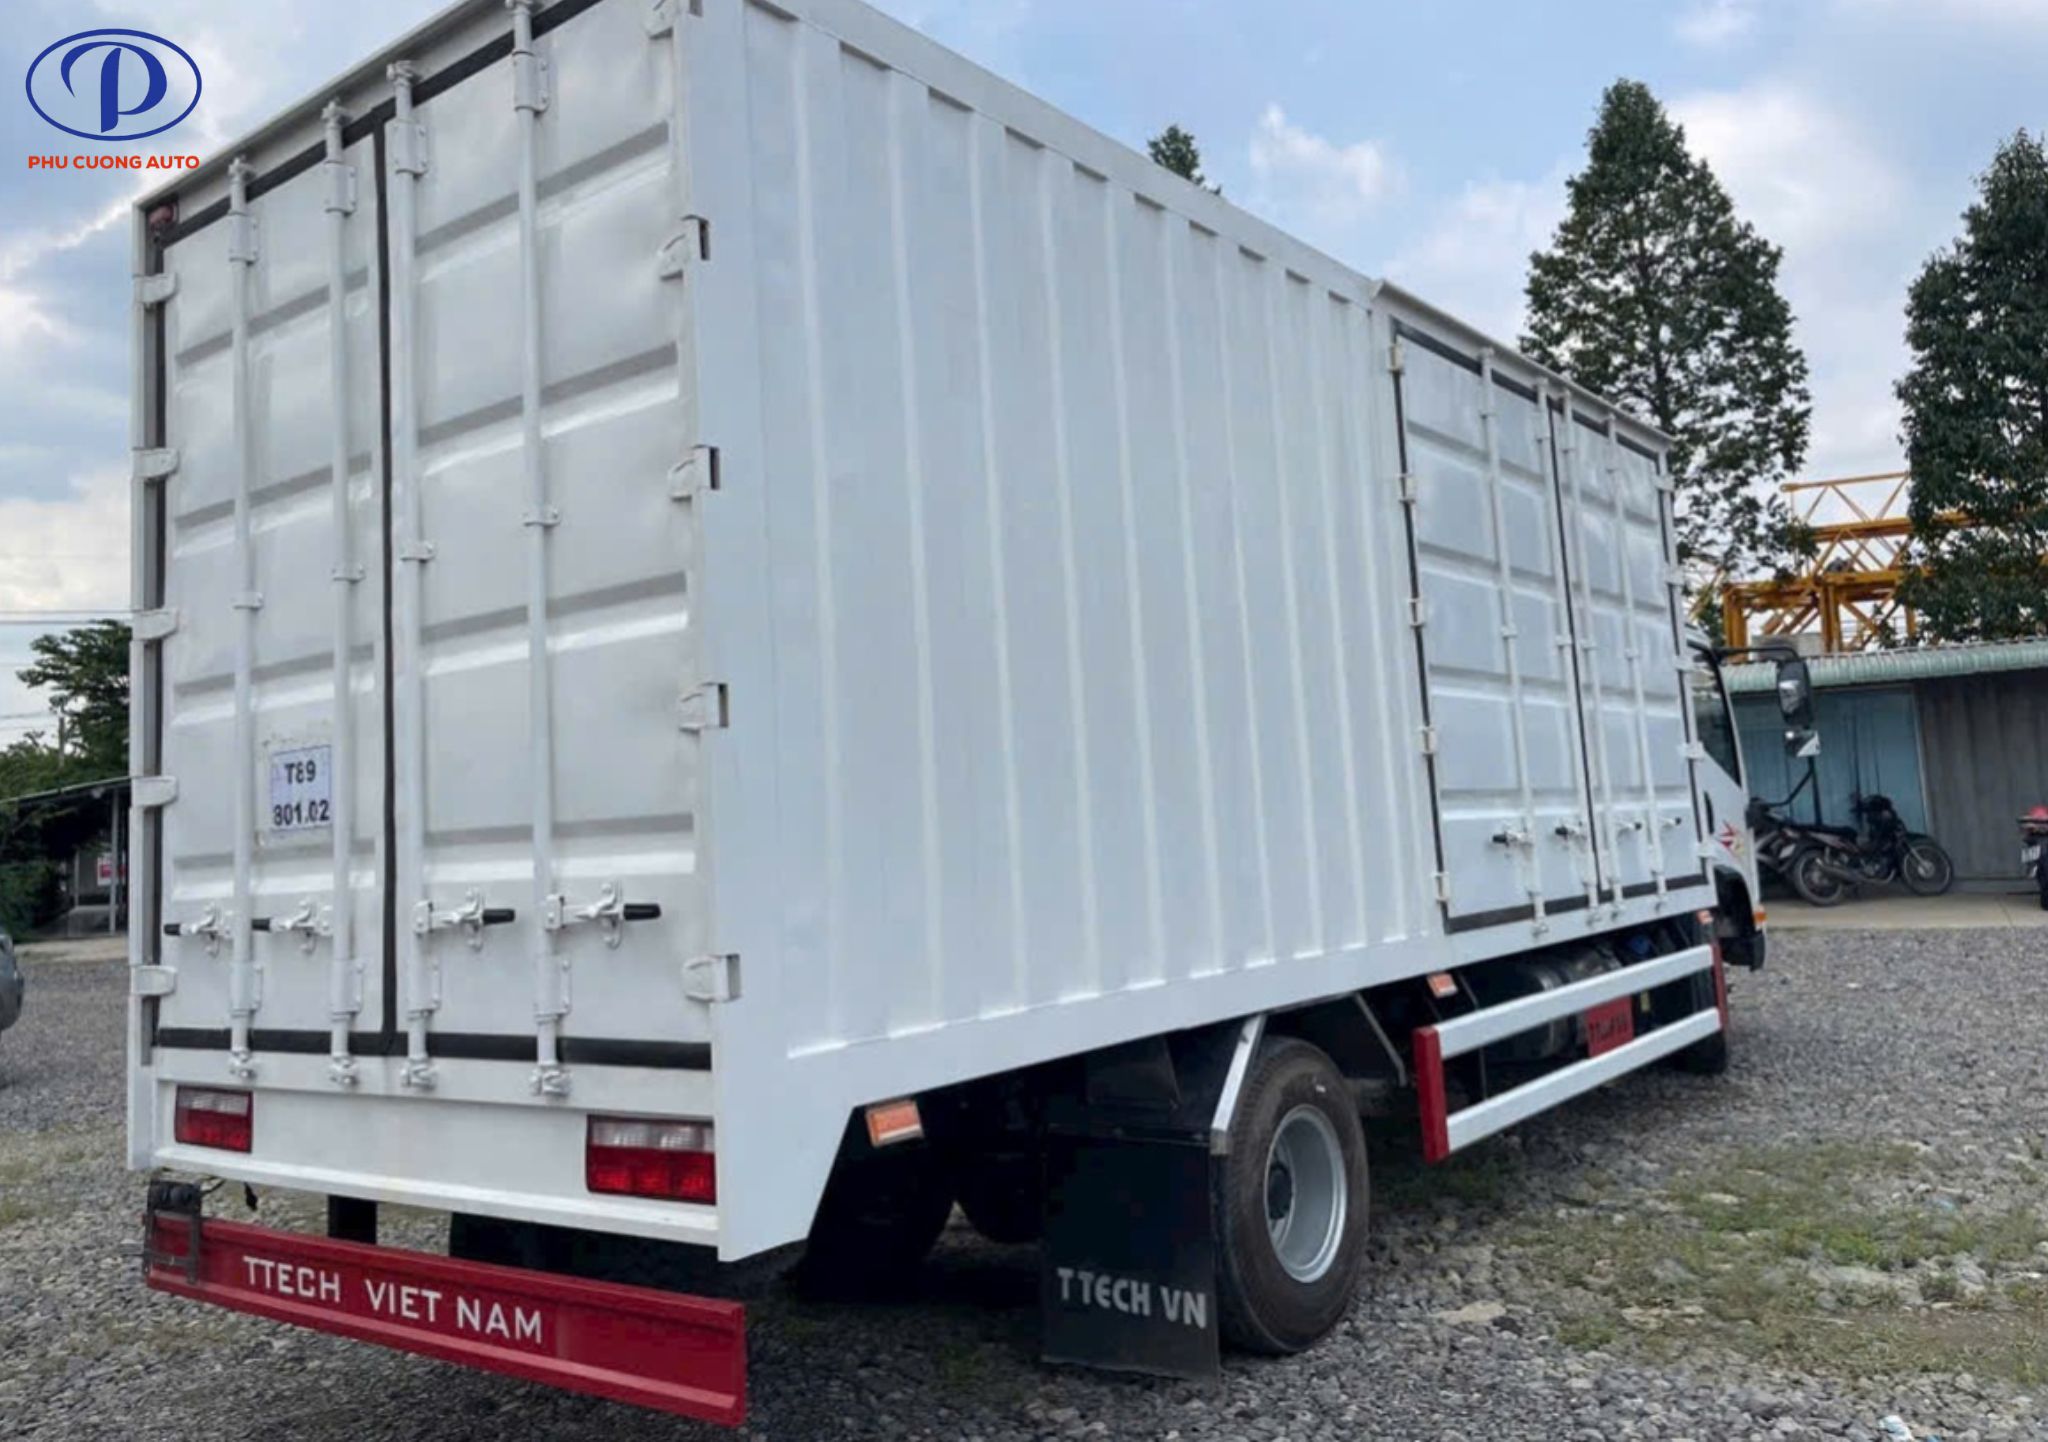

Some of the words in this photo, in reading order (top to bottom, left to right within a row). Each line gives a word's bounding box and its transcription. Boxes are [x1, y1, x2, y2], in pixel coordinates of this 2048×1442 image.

[242, 1255, 341, 1304] TTECH
[364, 1279, 443, 1323] VIET
[456, 1296, 542, 1345] NAM
[1159, 1285, 1207, 1329] VN
